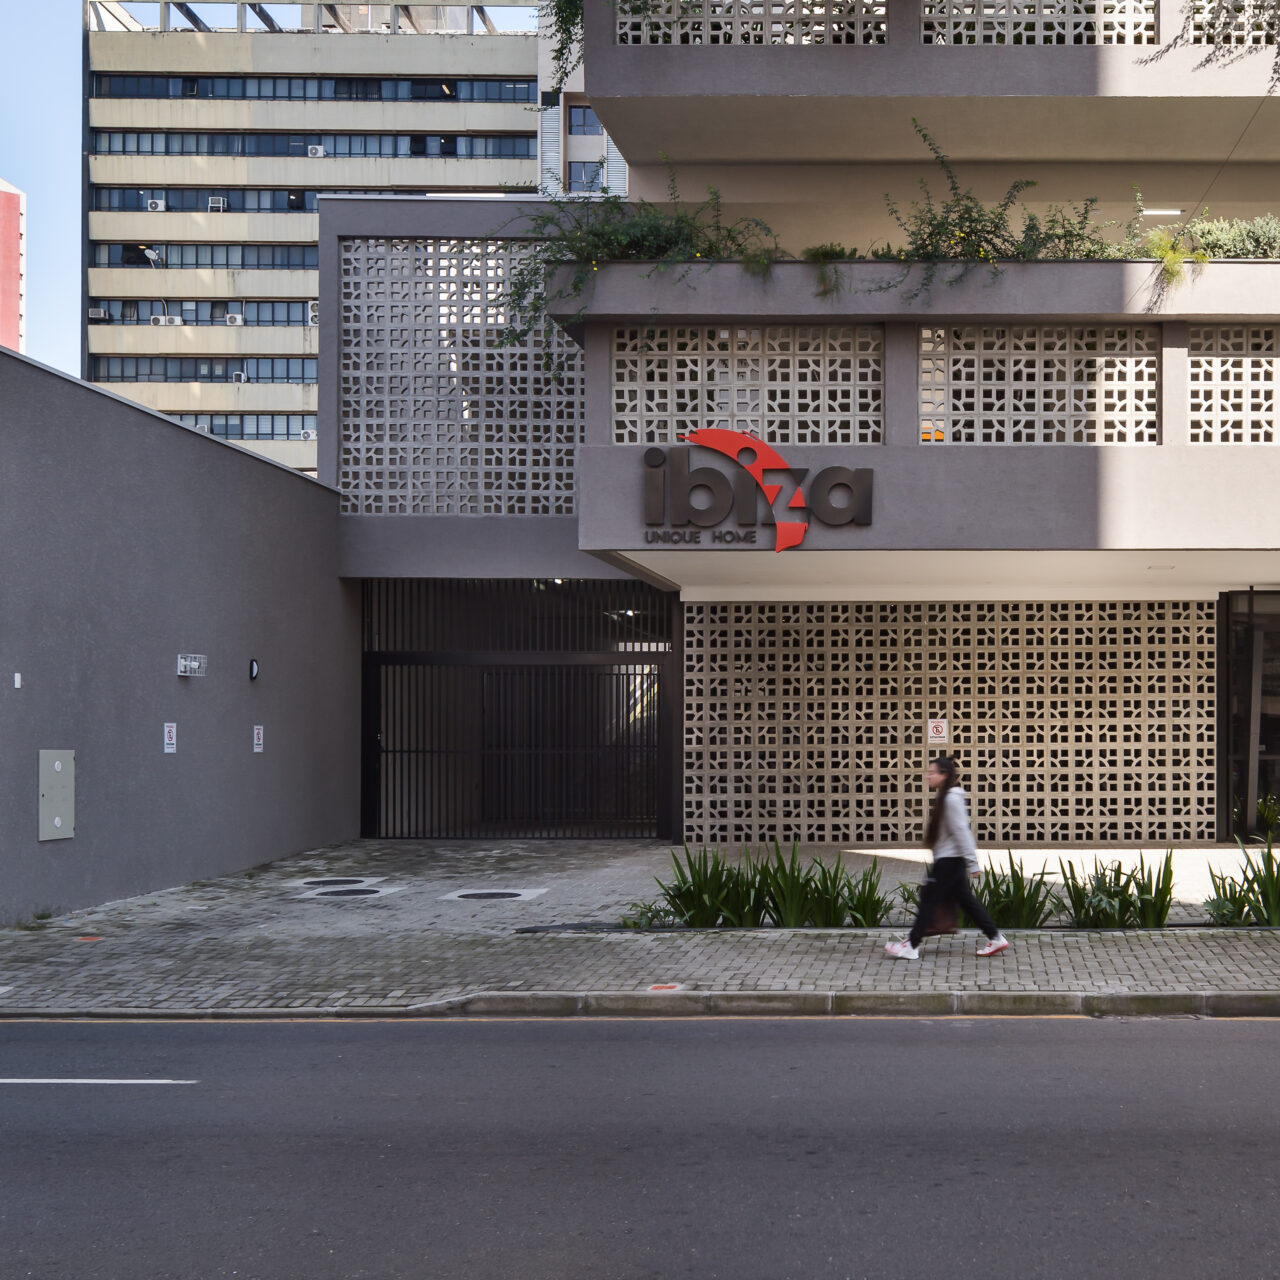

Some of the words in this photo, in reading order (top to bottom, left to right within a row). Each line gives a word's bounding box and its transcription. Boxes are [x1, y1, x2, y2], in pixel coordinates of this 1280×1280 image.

[644, 447, 873, 526] ibiza
[645, 530, 701, 544] UNIQUE
[712, 530, 757, 544] HOME
